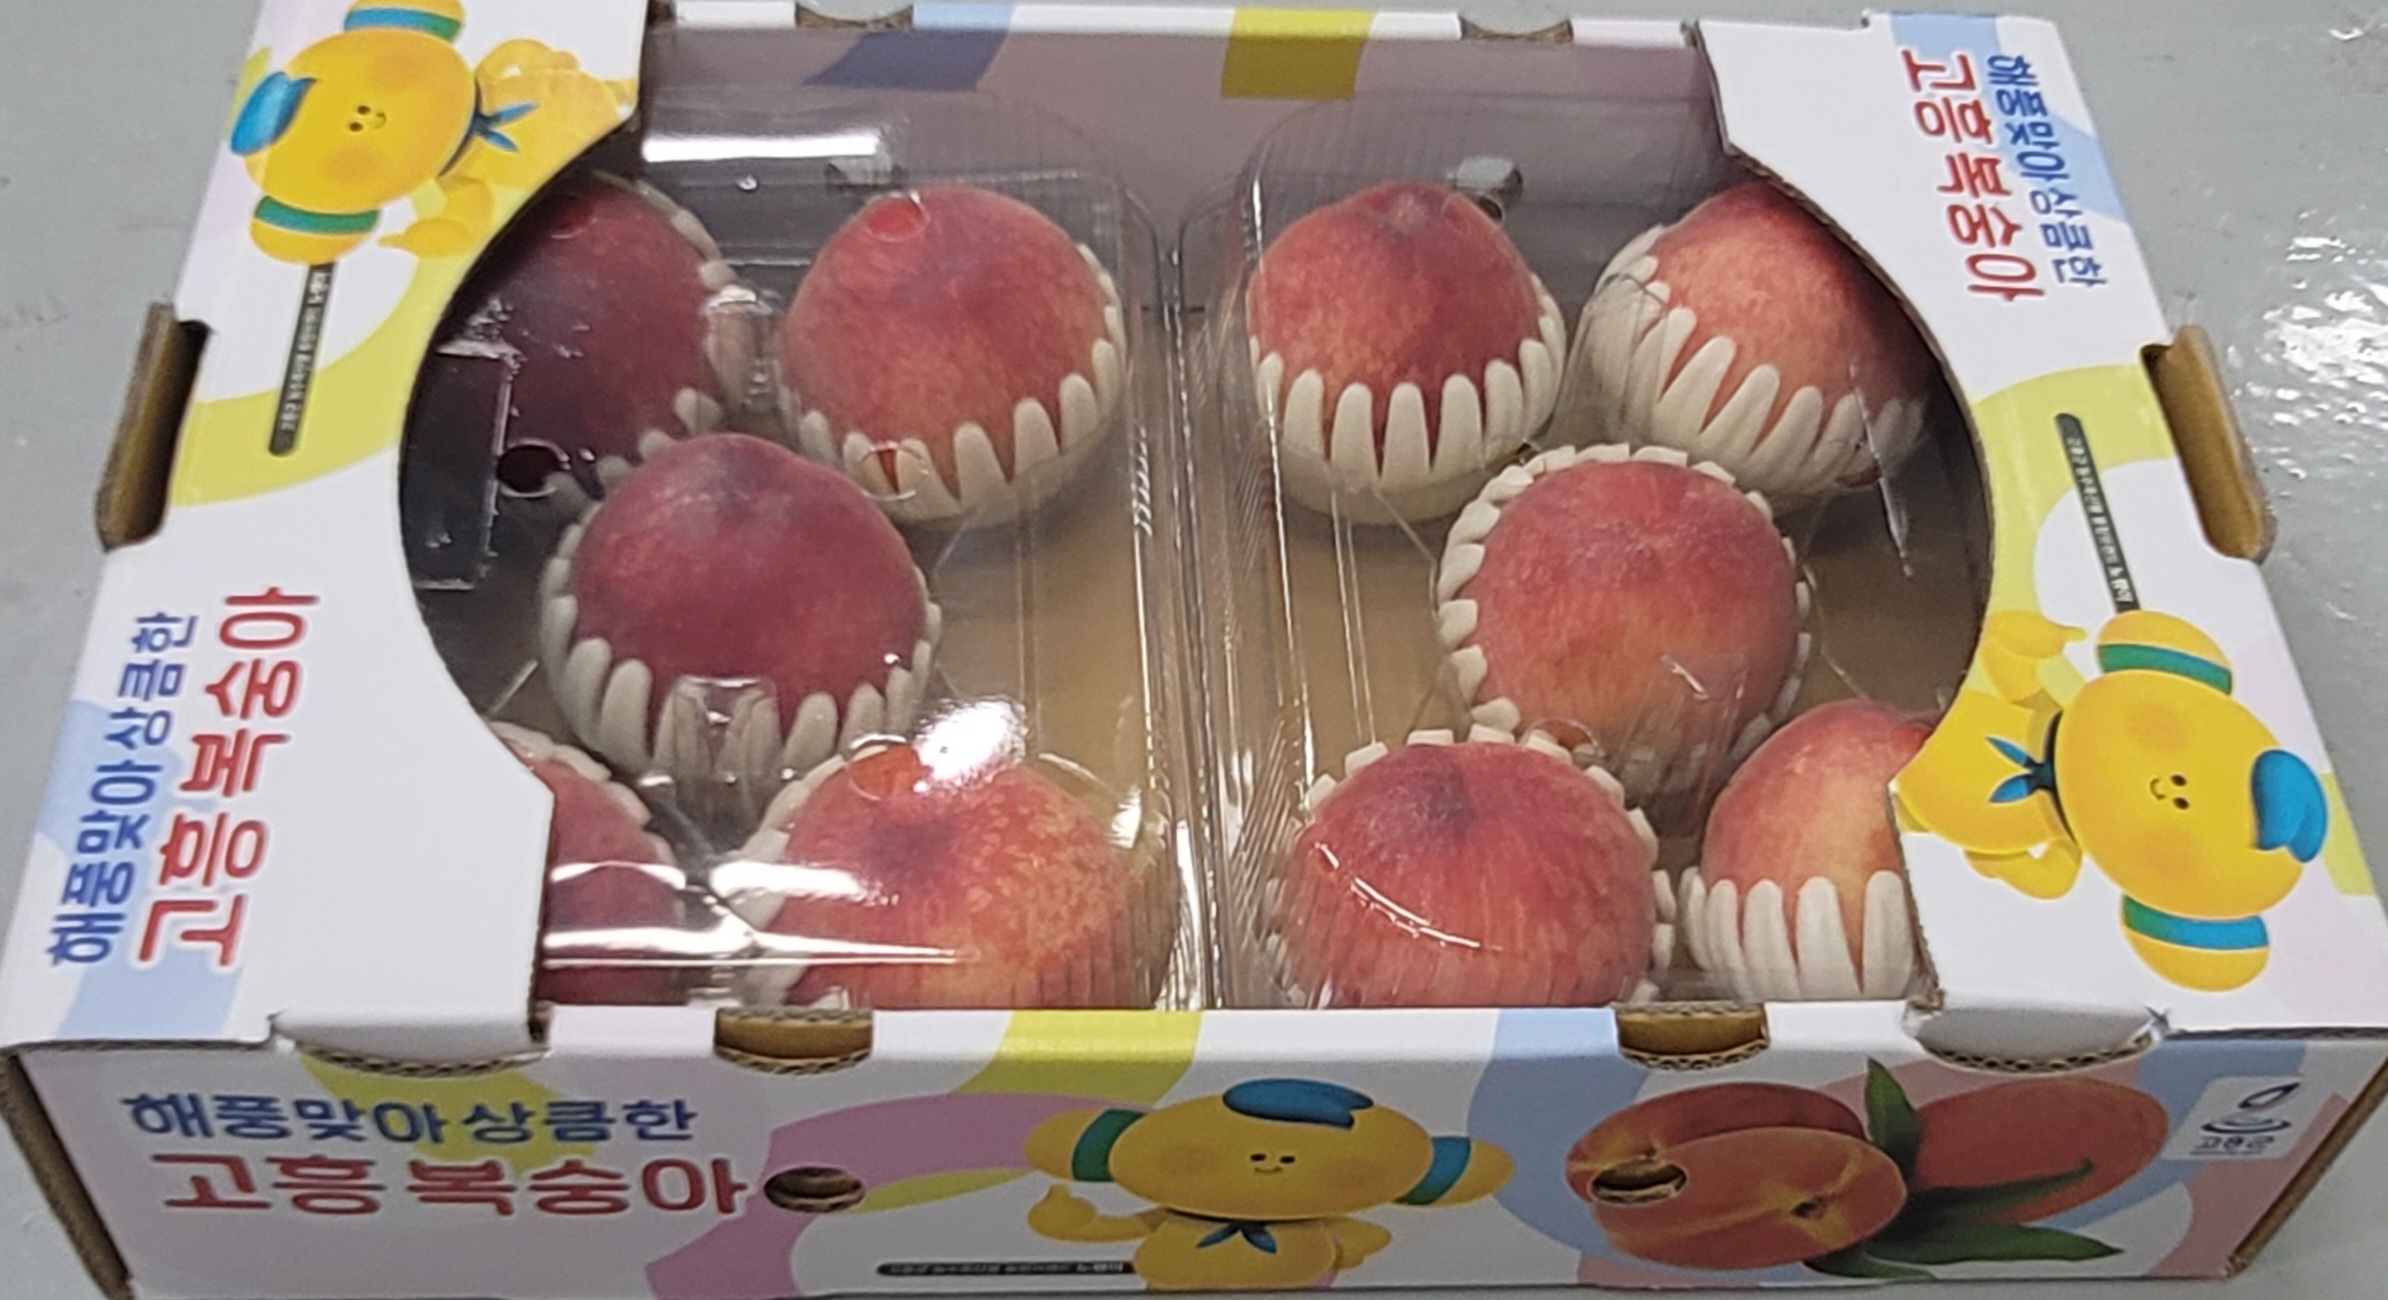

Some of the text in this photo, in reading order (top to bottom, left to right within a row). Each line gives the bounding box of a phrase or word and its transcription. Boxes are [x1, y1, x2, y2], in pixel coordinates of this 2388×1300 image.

[1900, 49, 2046, 302] 고흥 복숭아
[1986, 54, 2108, 287] 해풍맞아 상큼한
[46, 611, 199, 967] 해풍맞아 상큼한
[137, 586, 321, 967] 고흥 복숭아
[121, 1092, 698, 1145] 해풍맞아 상큼한
[151, 1153, 749, 1217] 고흥 복숭아
